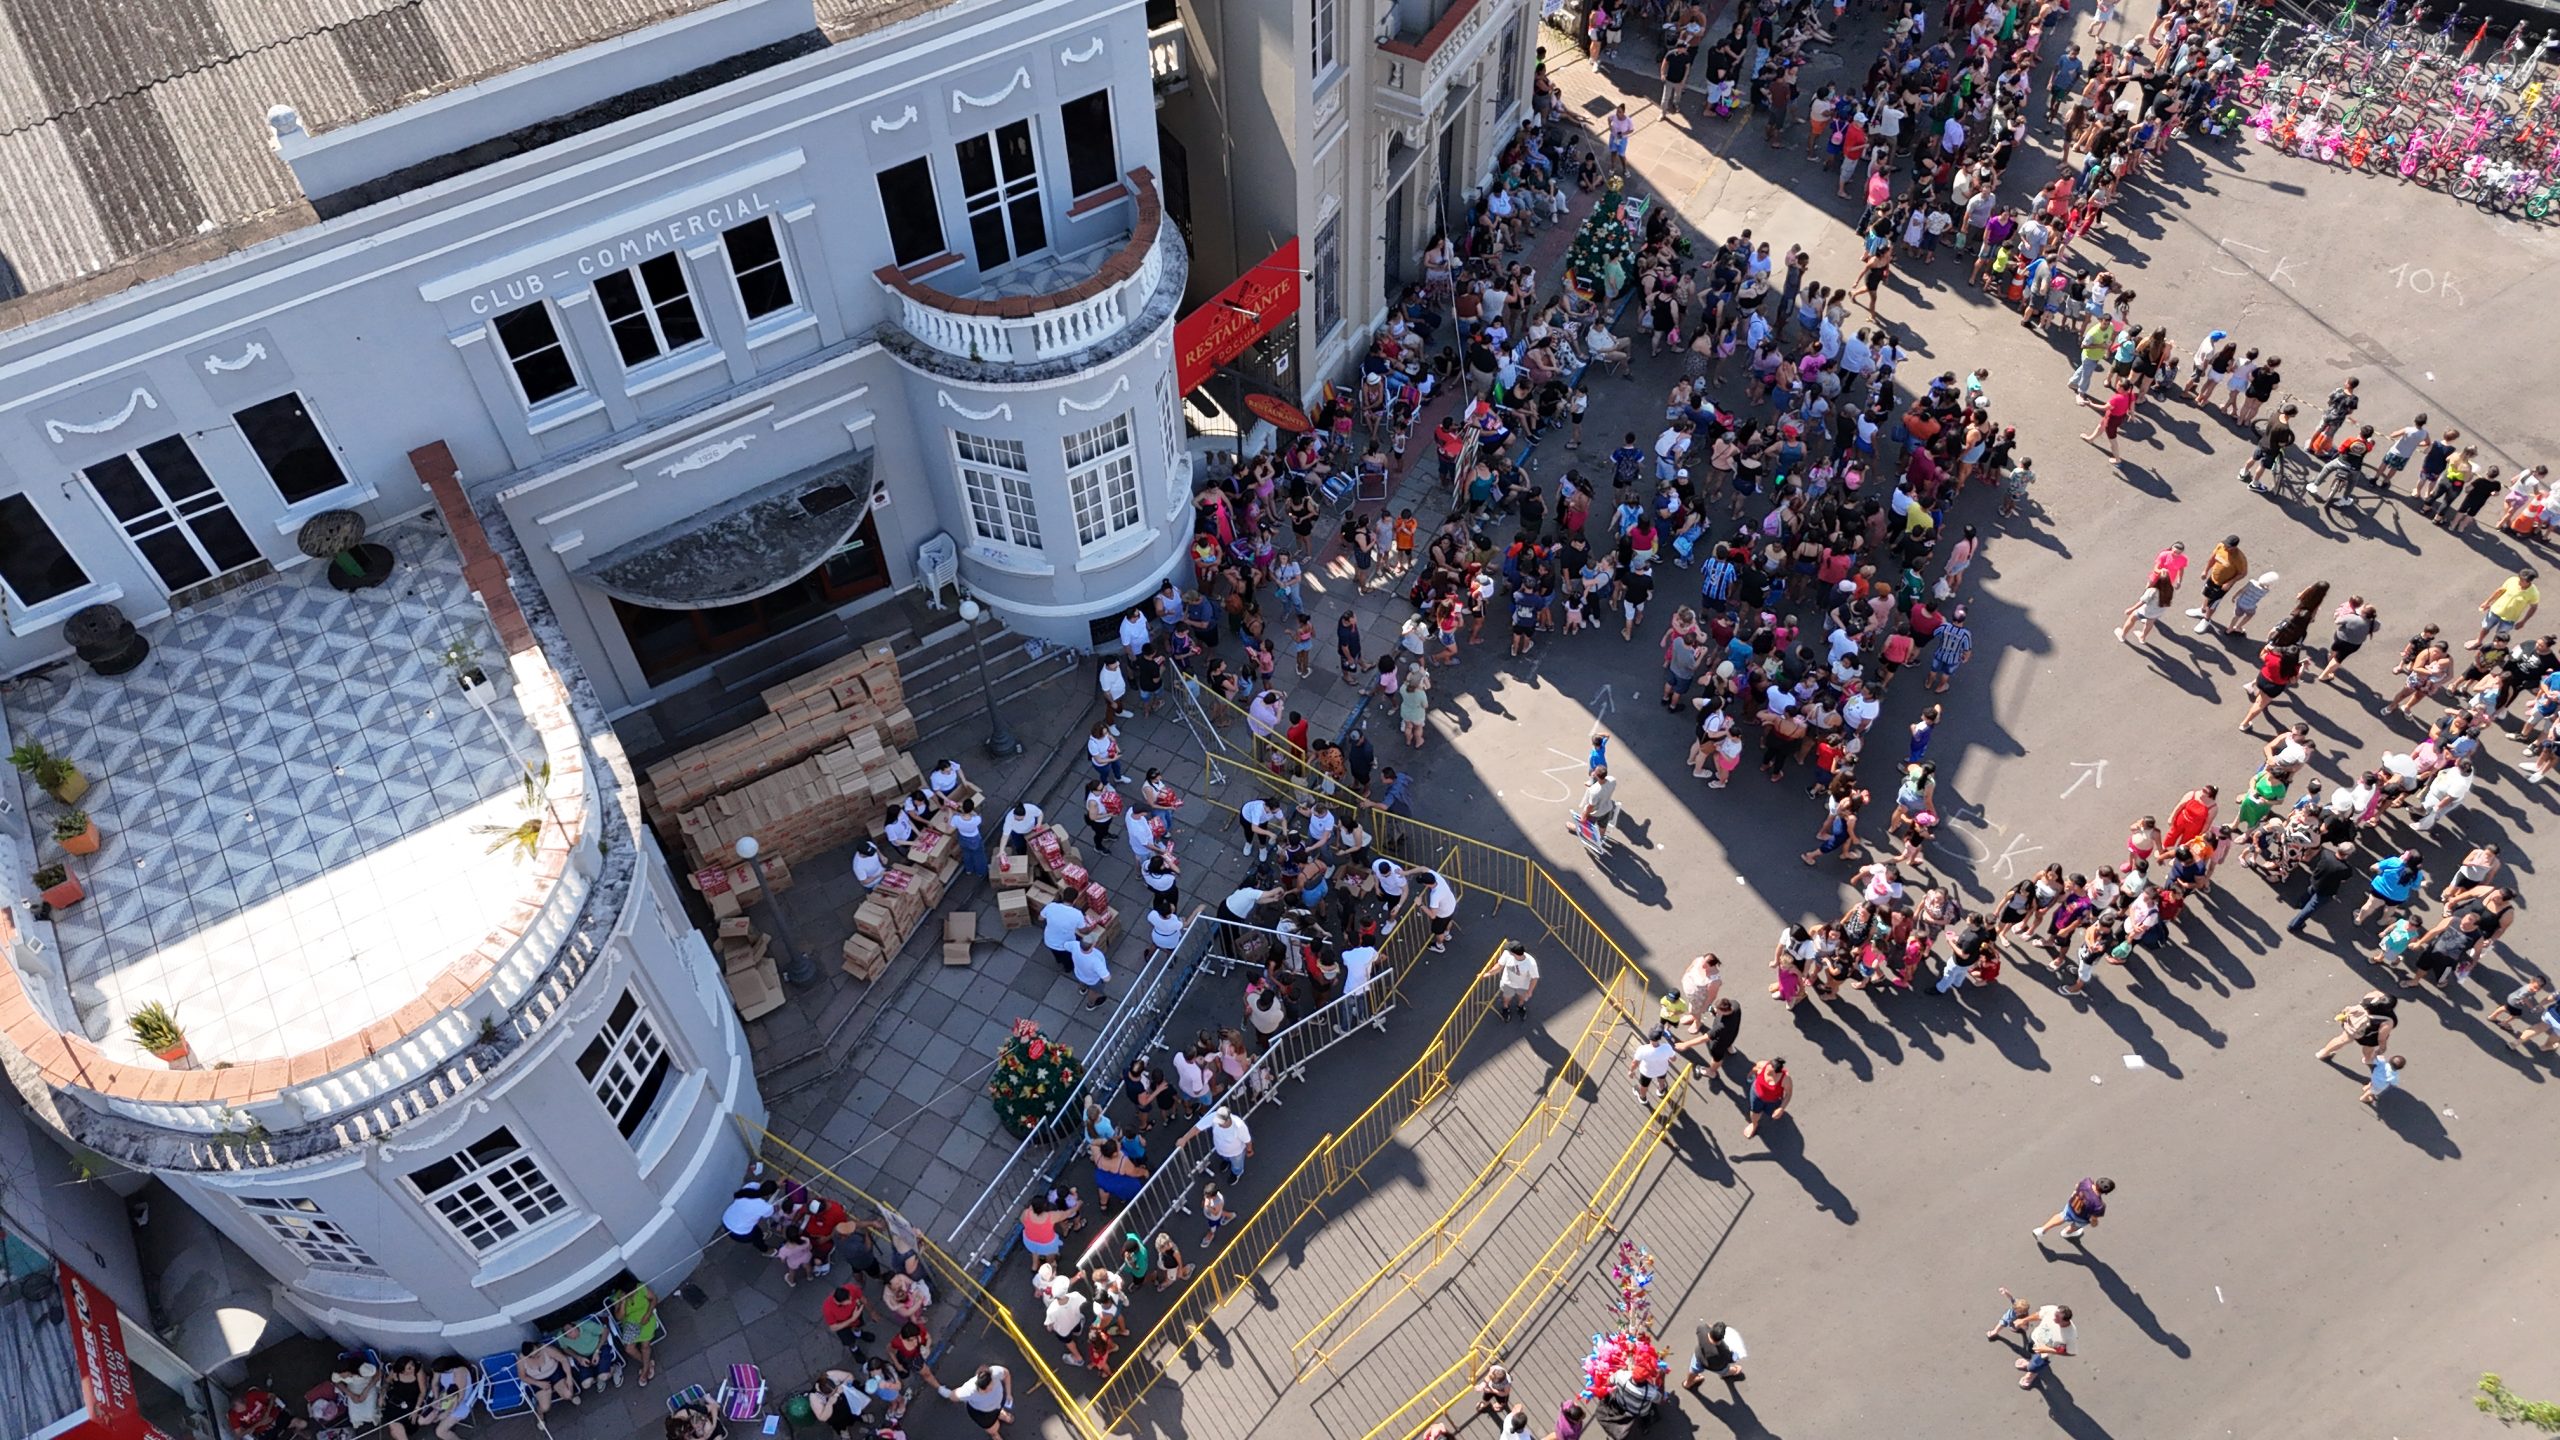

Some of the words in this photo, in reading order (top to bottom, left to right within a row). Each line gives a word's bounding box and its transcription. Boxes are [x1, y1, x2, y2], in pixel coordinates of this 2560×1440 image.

[469, 275, 544, 315] CLUB
[2388, 262, 2464, 306] 10K
[72, 1278, 92, 1326] TOP
[82, 1326, 107, 1405] SUPER
[99, 1324, 125, 1409] EXCLUSIVA
